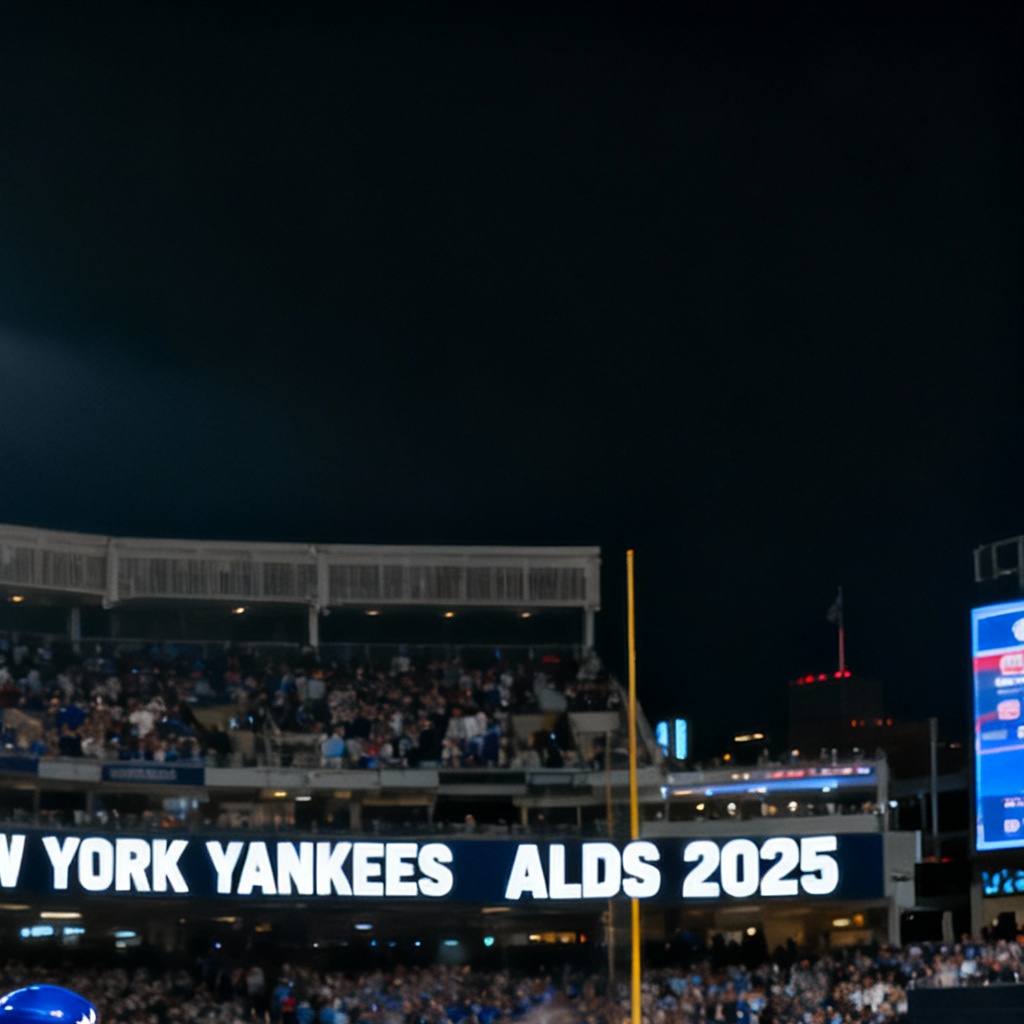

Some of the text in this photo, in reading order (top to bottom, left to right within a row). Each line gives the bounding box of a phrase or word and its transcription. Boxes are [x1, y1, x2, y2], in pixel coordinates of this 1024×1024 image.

[42, 836, 189, 893] YORK
[205, 840, 454, 897] YANKEES
[505, 841, 661, 900] ALDS
[682, 835, 839, 898] 2025
